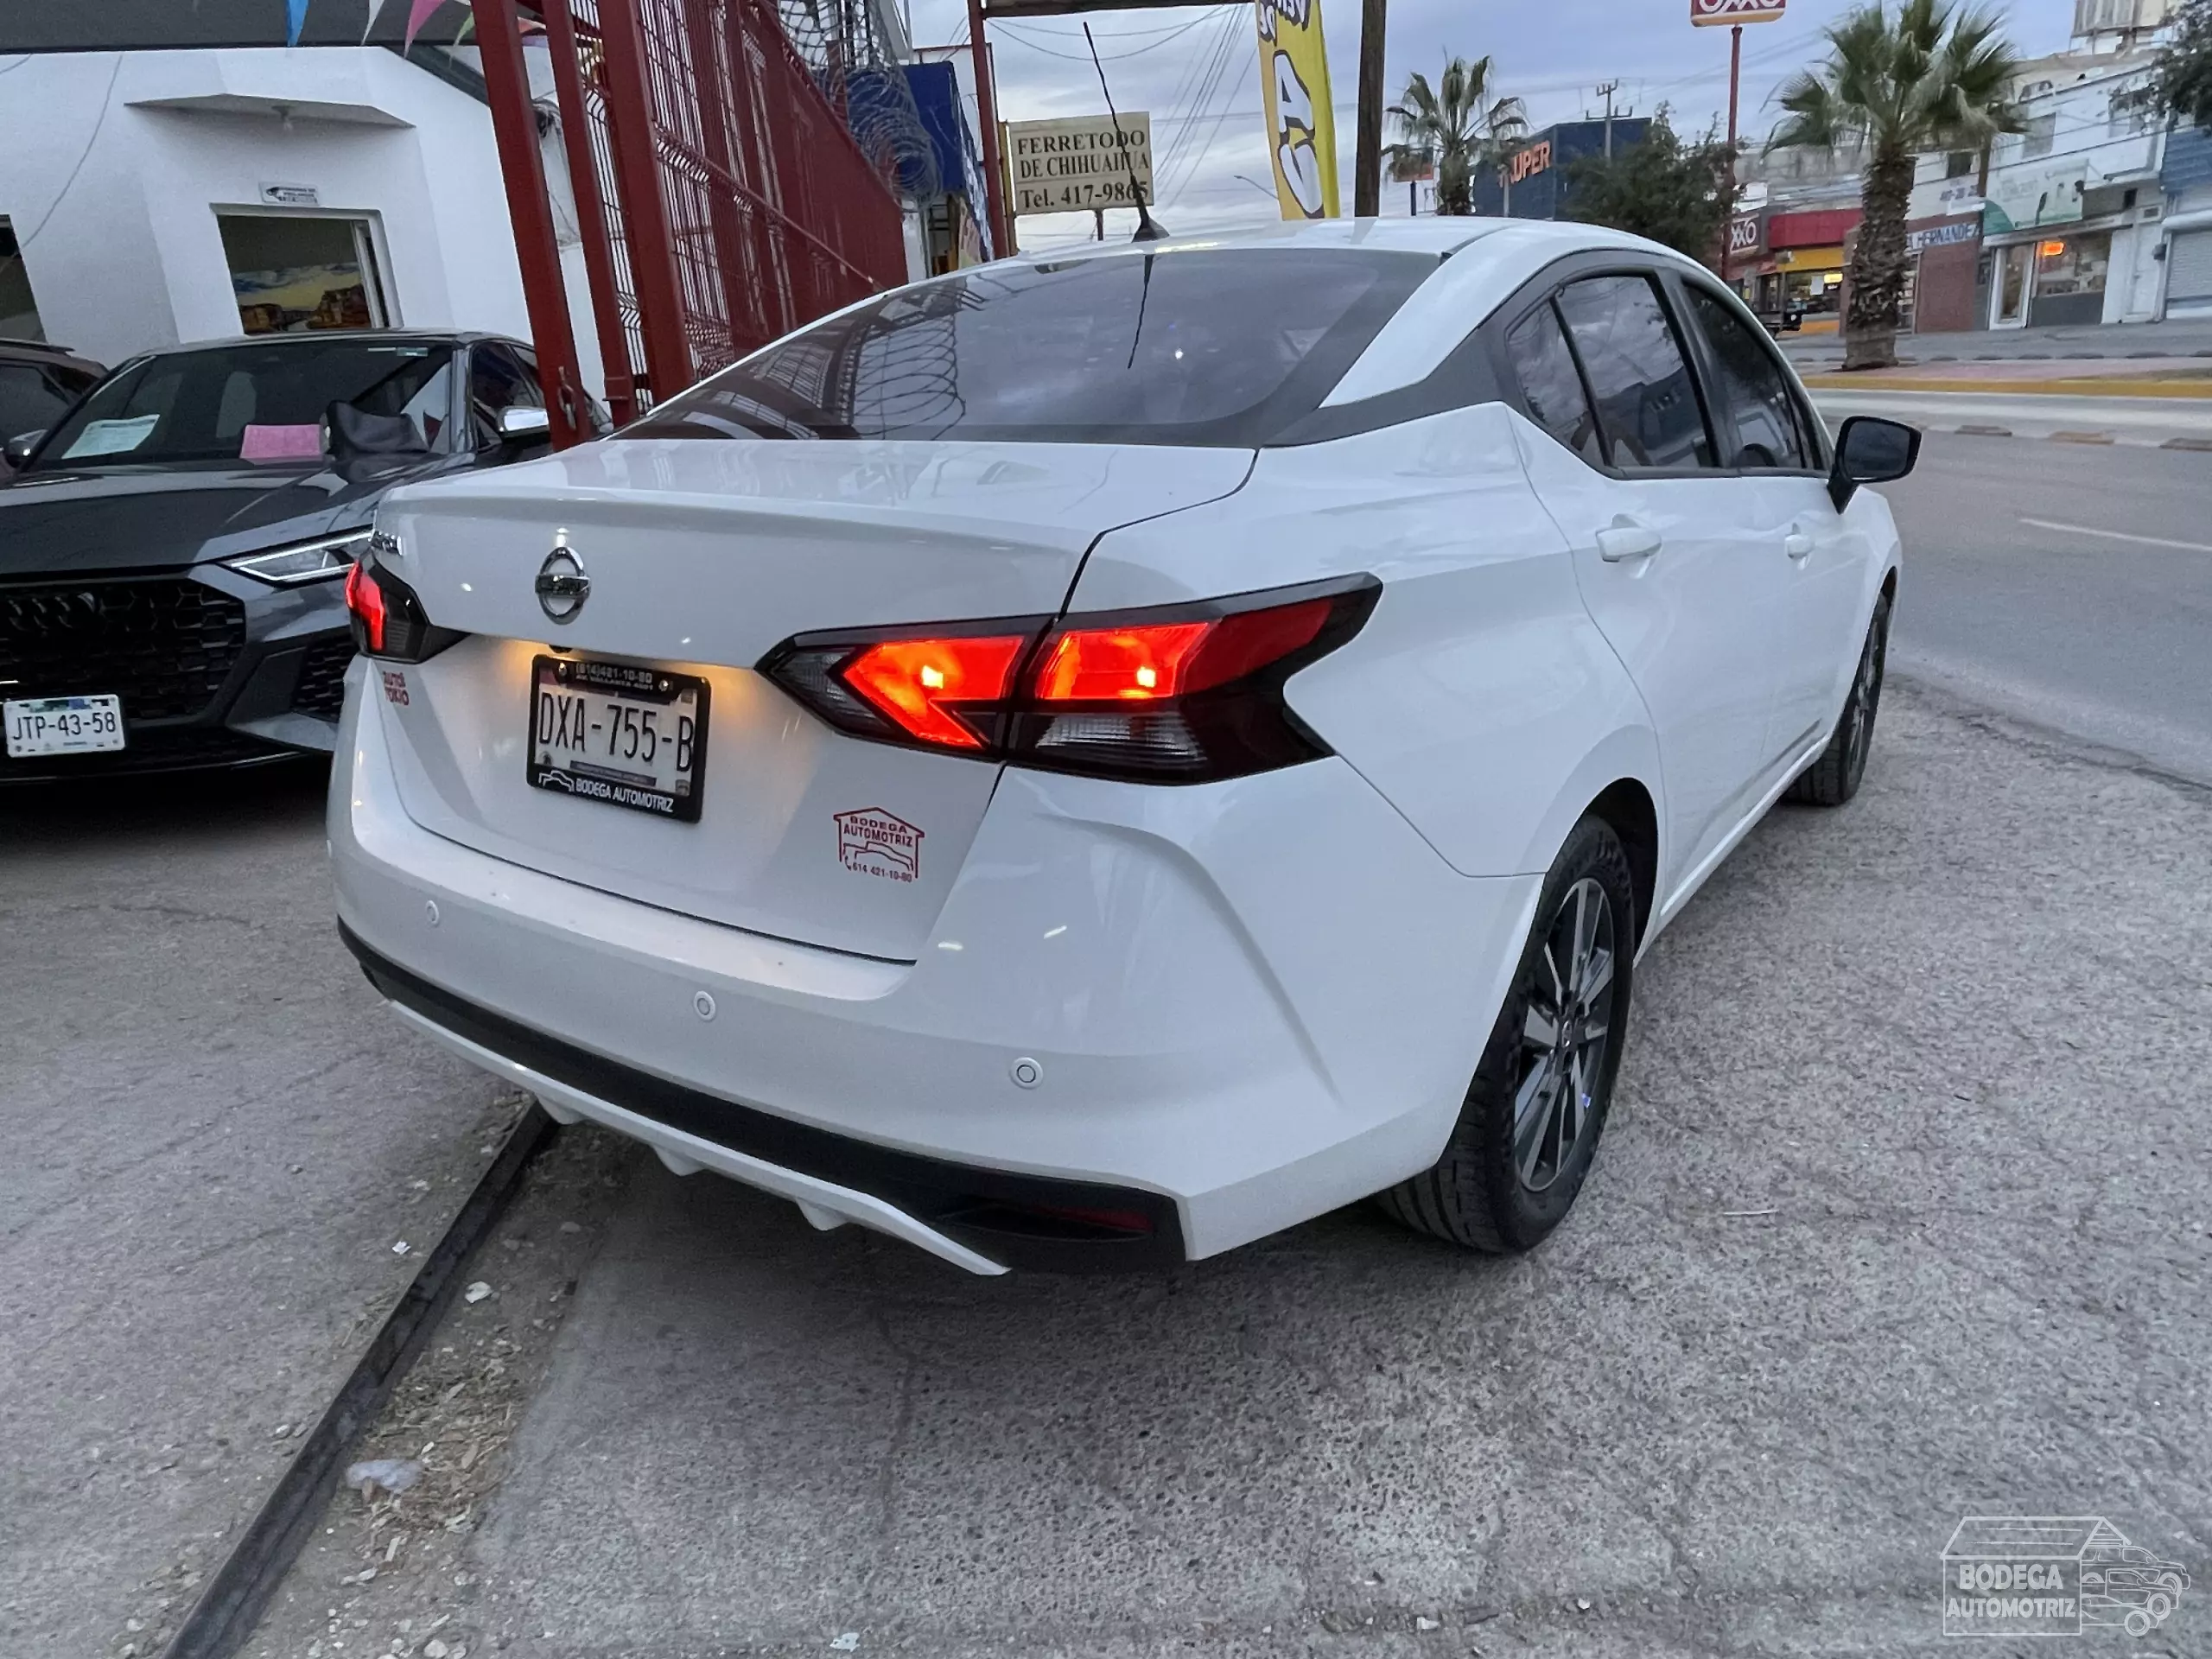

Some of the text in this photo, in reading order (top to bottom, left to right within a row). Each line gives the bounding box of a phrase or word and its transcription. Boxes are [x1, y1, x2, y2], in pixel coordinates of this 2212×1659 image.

[1018, 130, 1145, 155] FERRETODO
[1020, 151, 1149, 178] DE CHIHUAHUA
[1498, 141, 1551, 188] UPER
[1020, 189, 1054, 208] Tel.
[1730, 222, 1757, 251] XXO
[13, 712, 116, 741] JTP-43-58
[539, 693, 695, 772] DXA-755-B
[576, 778, 674, 812] BODEGA AUTOMOTRIZ
[843, 823, 913, 848] AUTOMOTRIZ
[850, 816, 907, 834] BODEGA
